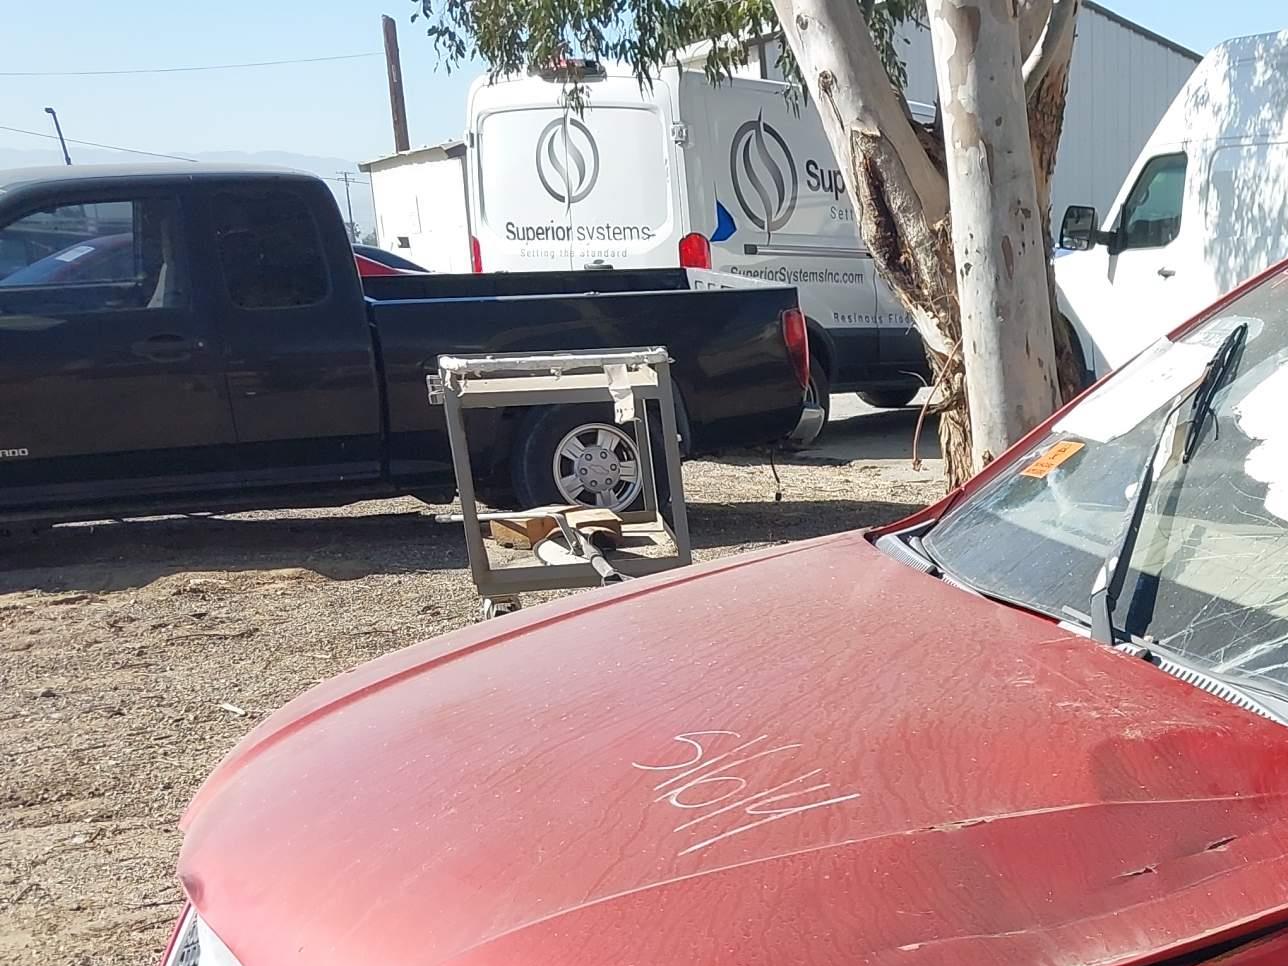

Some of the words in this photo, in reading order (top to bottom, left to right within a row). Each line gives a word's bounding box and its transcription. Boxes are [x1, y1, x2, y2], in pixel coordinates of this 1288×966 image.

[806, 159, 845, 200] Sup
[505, 219, 572, 245] Superior
[576, 223, 651, 245] systems
